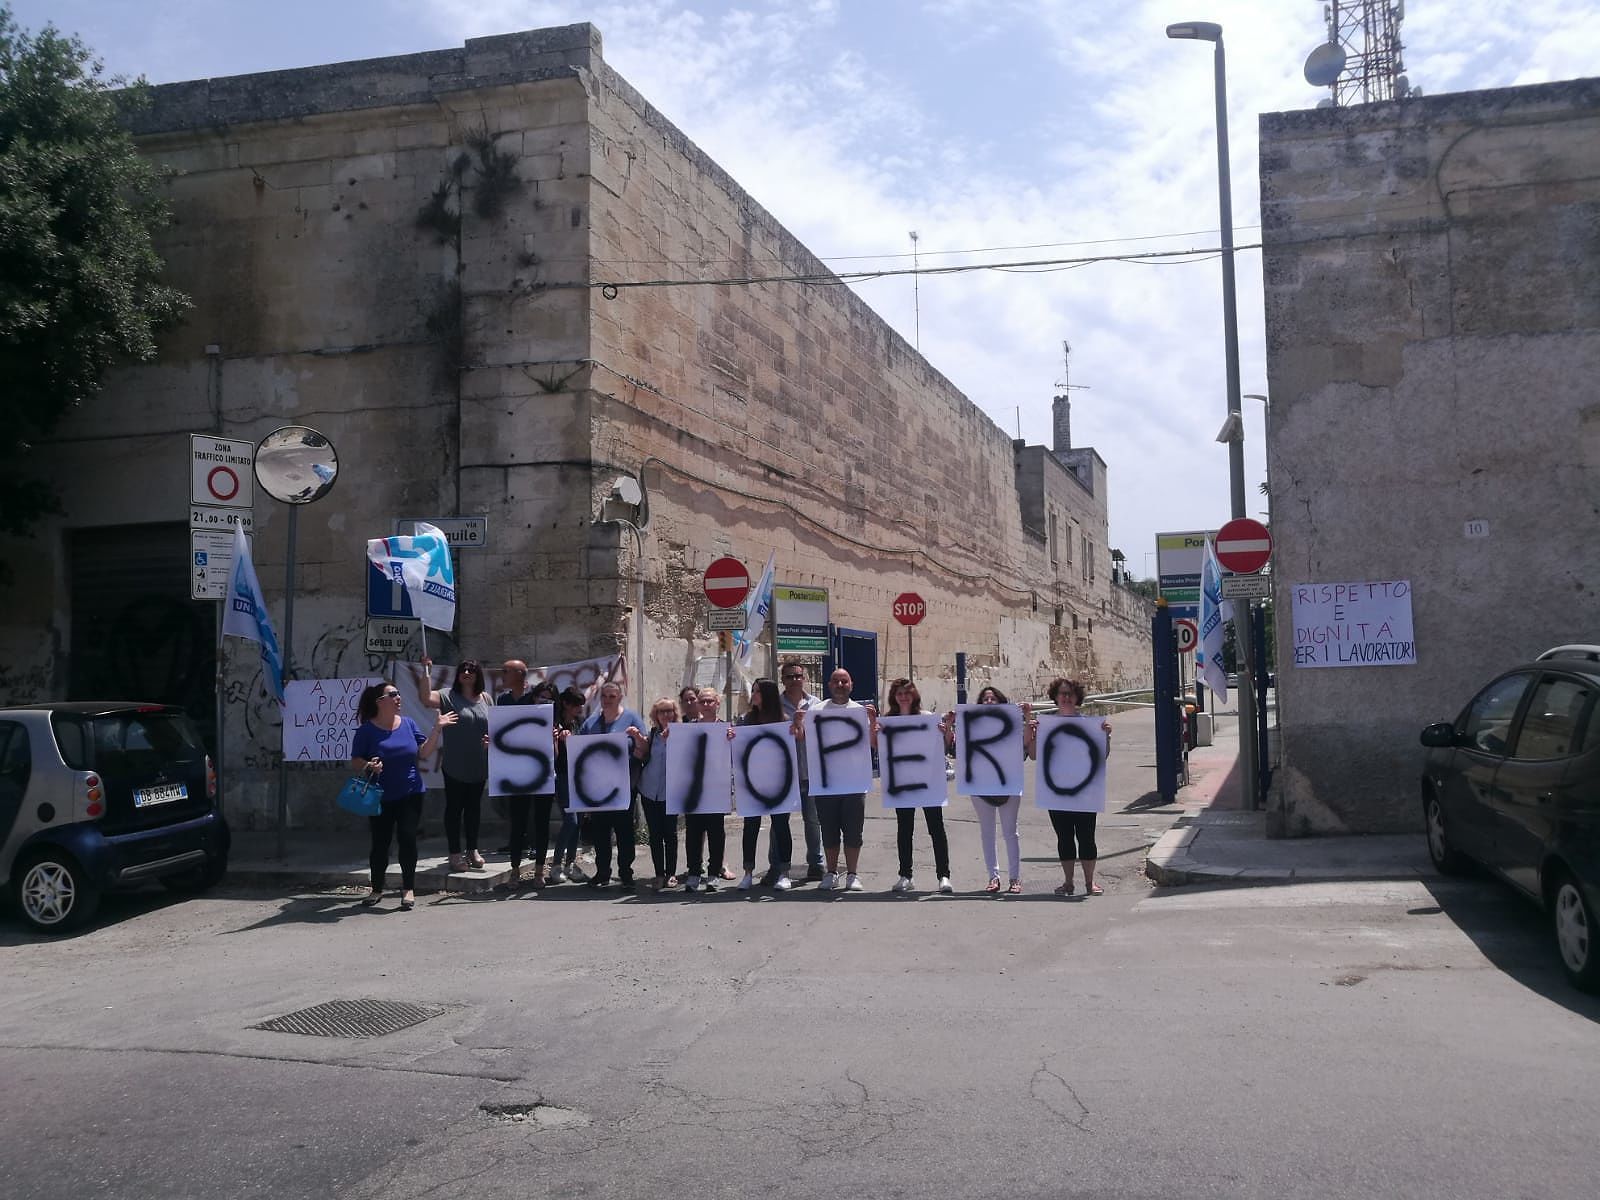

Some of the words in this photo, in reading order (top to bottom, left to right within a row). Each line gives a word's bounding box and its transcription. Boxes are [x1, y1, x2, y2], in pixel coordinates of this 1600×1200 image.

[214, 443, 231, 454] ZONA
[194, 451, 224, 462] TRAFFICO
[225, 455, 251, 465] LIMITATO
[193, 512, 218, 523] 21.00
[1469, 523, 1482, 535] 10
[1298, 582, 1408, 605] RISPETTO
[894, 604, 923, 616] STOP
[1334, 604, 1345, 621] E
[382, 625, 409, 635] strada
[369, 638, 392, 648] senza
[1338, 641, 1415, 662] LAVORATORI
[310, 680, 324, 695] A
[319, 694, 360, 711] PIAC
[294, 712, 360, 727] LAVORA
[297, 746, 311, 760] A
